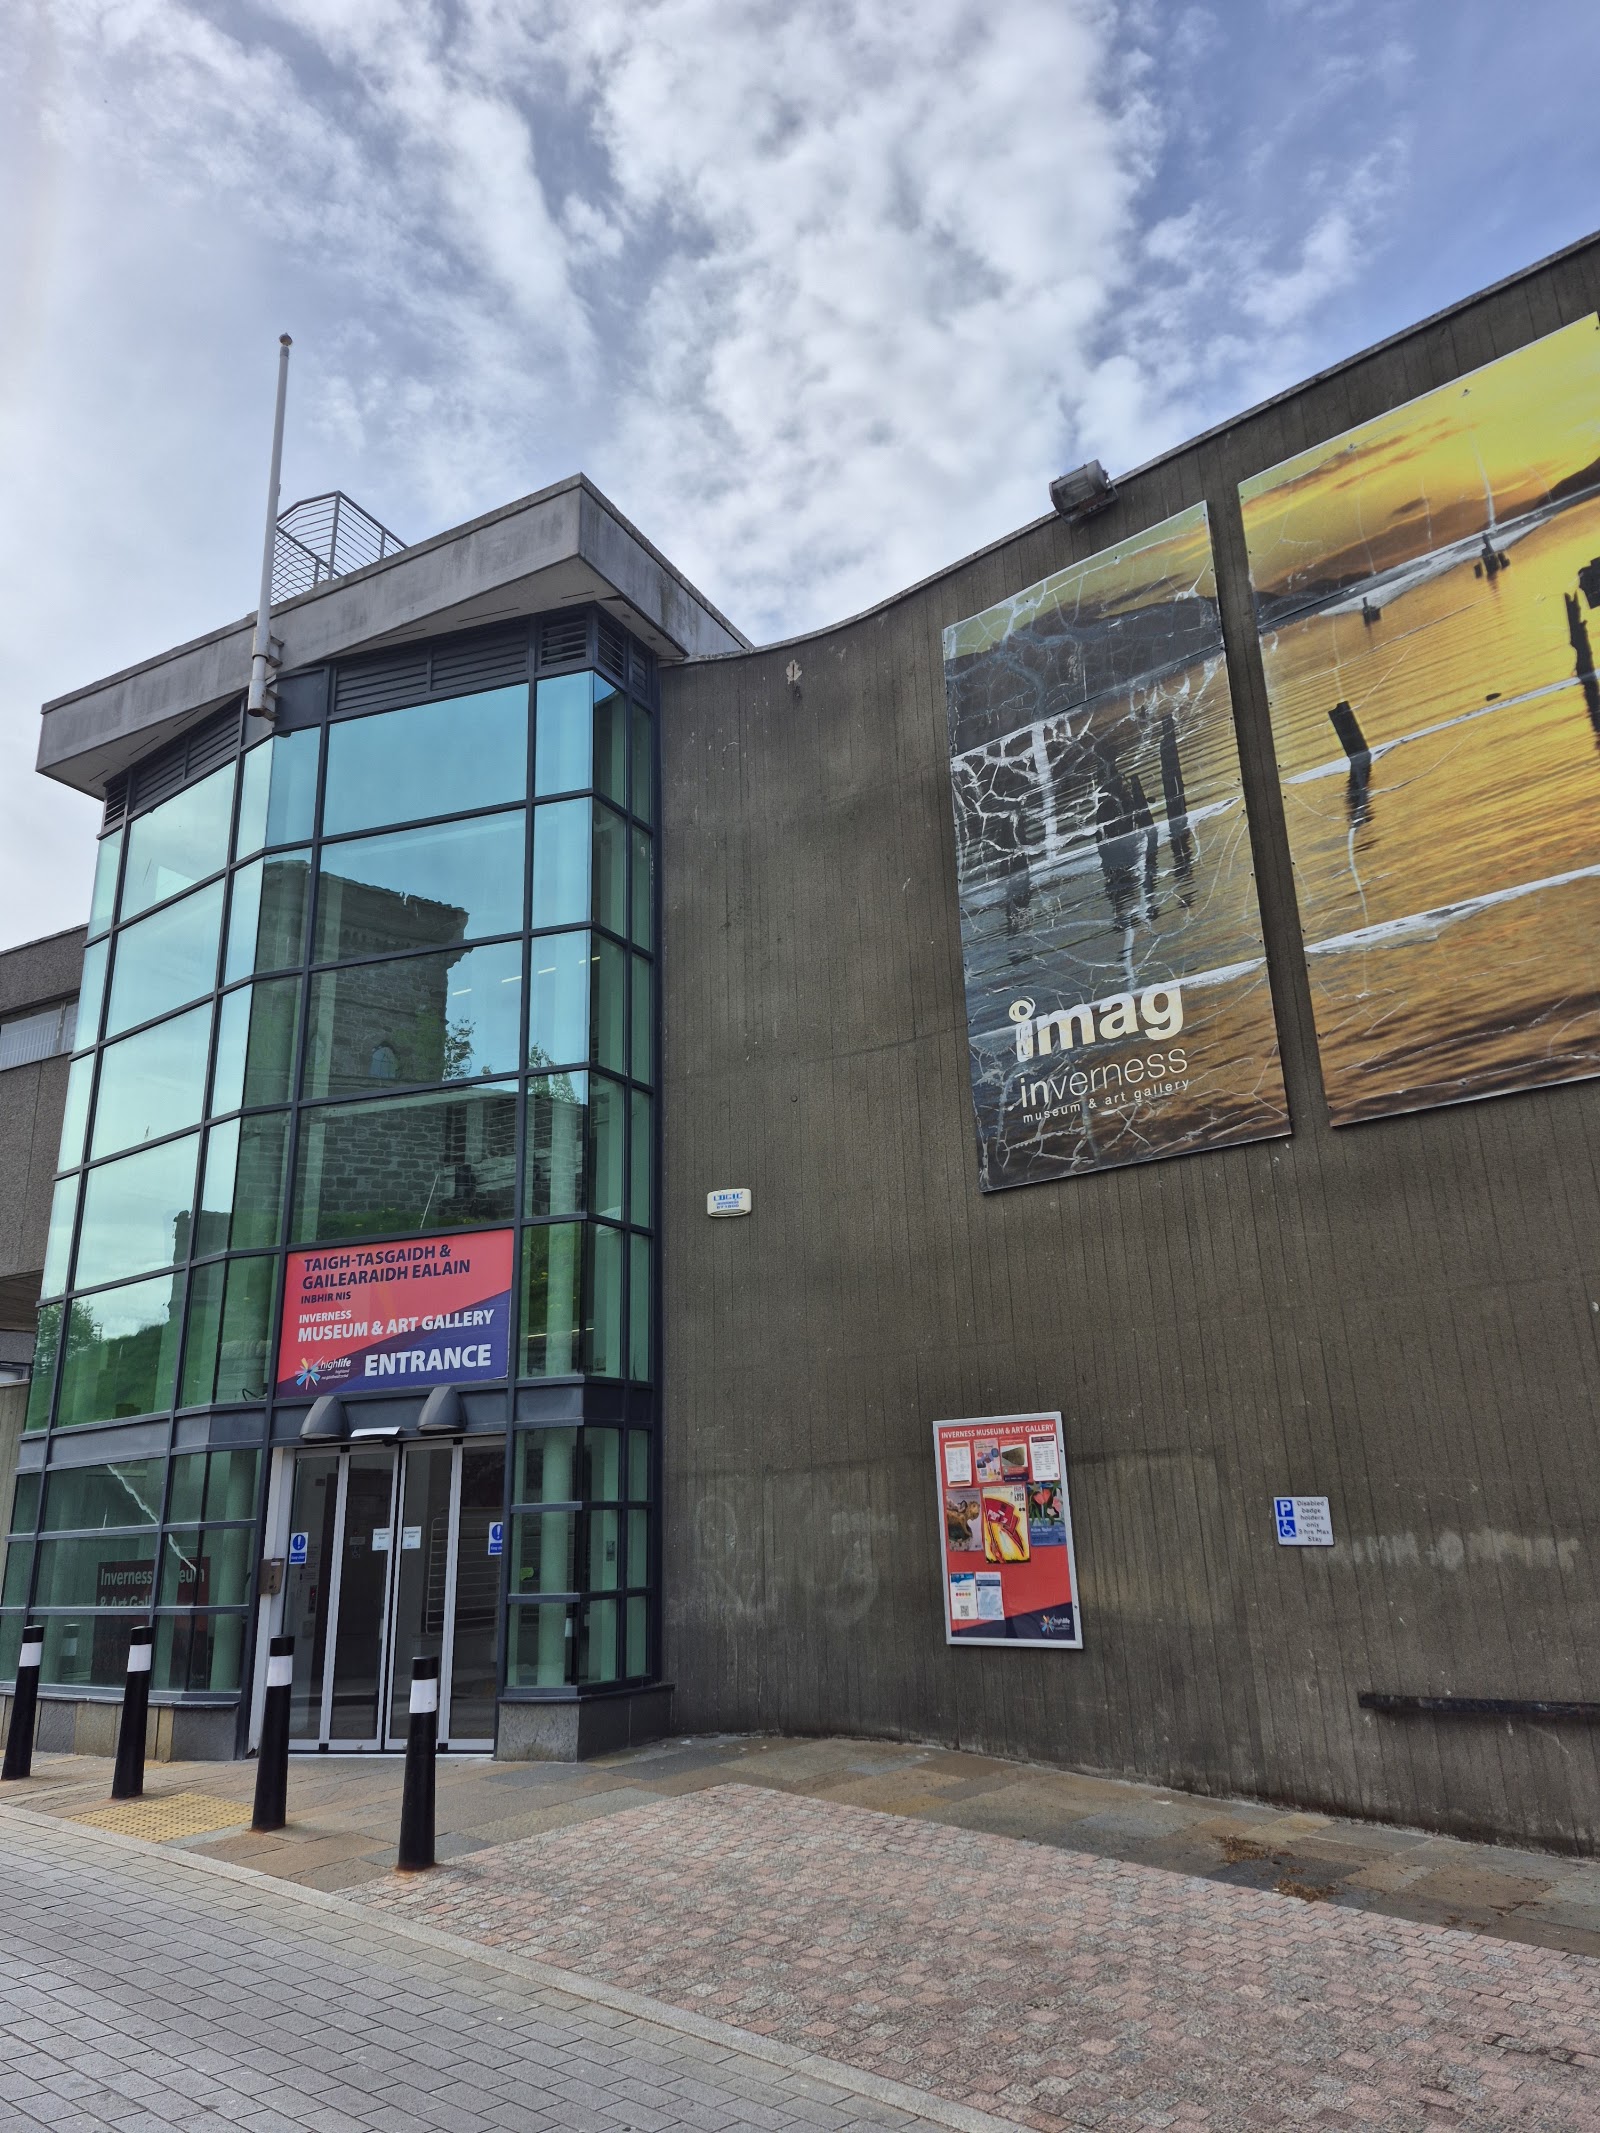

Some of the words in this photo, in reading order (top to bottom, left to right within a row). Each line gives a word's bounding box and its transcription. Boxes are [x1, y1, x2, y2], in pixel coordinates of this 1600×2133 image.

[1009, 982, 1184, 1062] imag
[1020, 1048, 1188, 1108] inverness
[1023, 1104, 1081, 1124] museum
[1089, 1098, 1098, 1109] &
[1105, 1091, 1126, 1105] art
[1134, 1079, 1190, 1101] gallery
[304, 1245, 436, 1272] TAIGH-TASGAIDH
[439, 1244, 451, 1258] &
[302, 1266, 408, 1290] GAILEARAIDH
[412, 1259, 471, 1279] EALAIN
[301, 1293, 334, 1304] INBHIR
[335, 1291, 352, 1302] NIS
[298, 1321, 368, 1343] MUSEUM
[371, 1320, 384, 1336] &
[386, 1316, 419, 1334] ART
[421, 1308, 495, 1330] GALLERY
[299, 1310, 352, 1323] INVERNESS
[320, 1357, 352, 1371] highlife
[364, 1343, 492, 1377] ENTRANCE
[941, 1429, 976, 1439] INVERNESS
[976, 1427, 1005, 1436] MUSEUM
[1005, 1426, 1010, 1434] &
[1011, 1425, 1024, 1434] ART
[1025, 1423, 1054, 1433] GALLERY
[1280, 1501, 1291, 1516] P
[100, 1568, 153, 1586] Inverness
